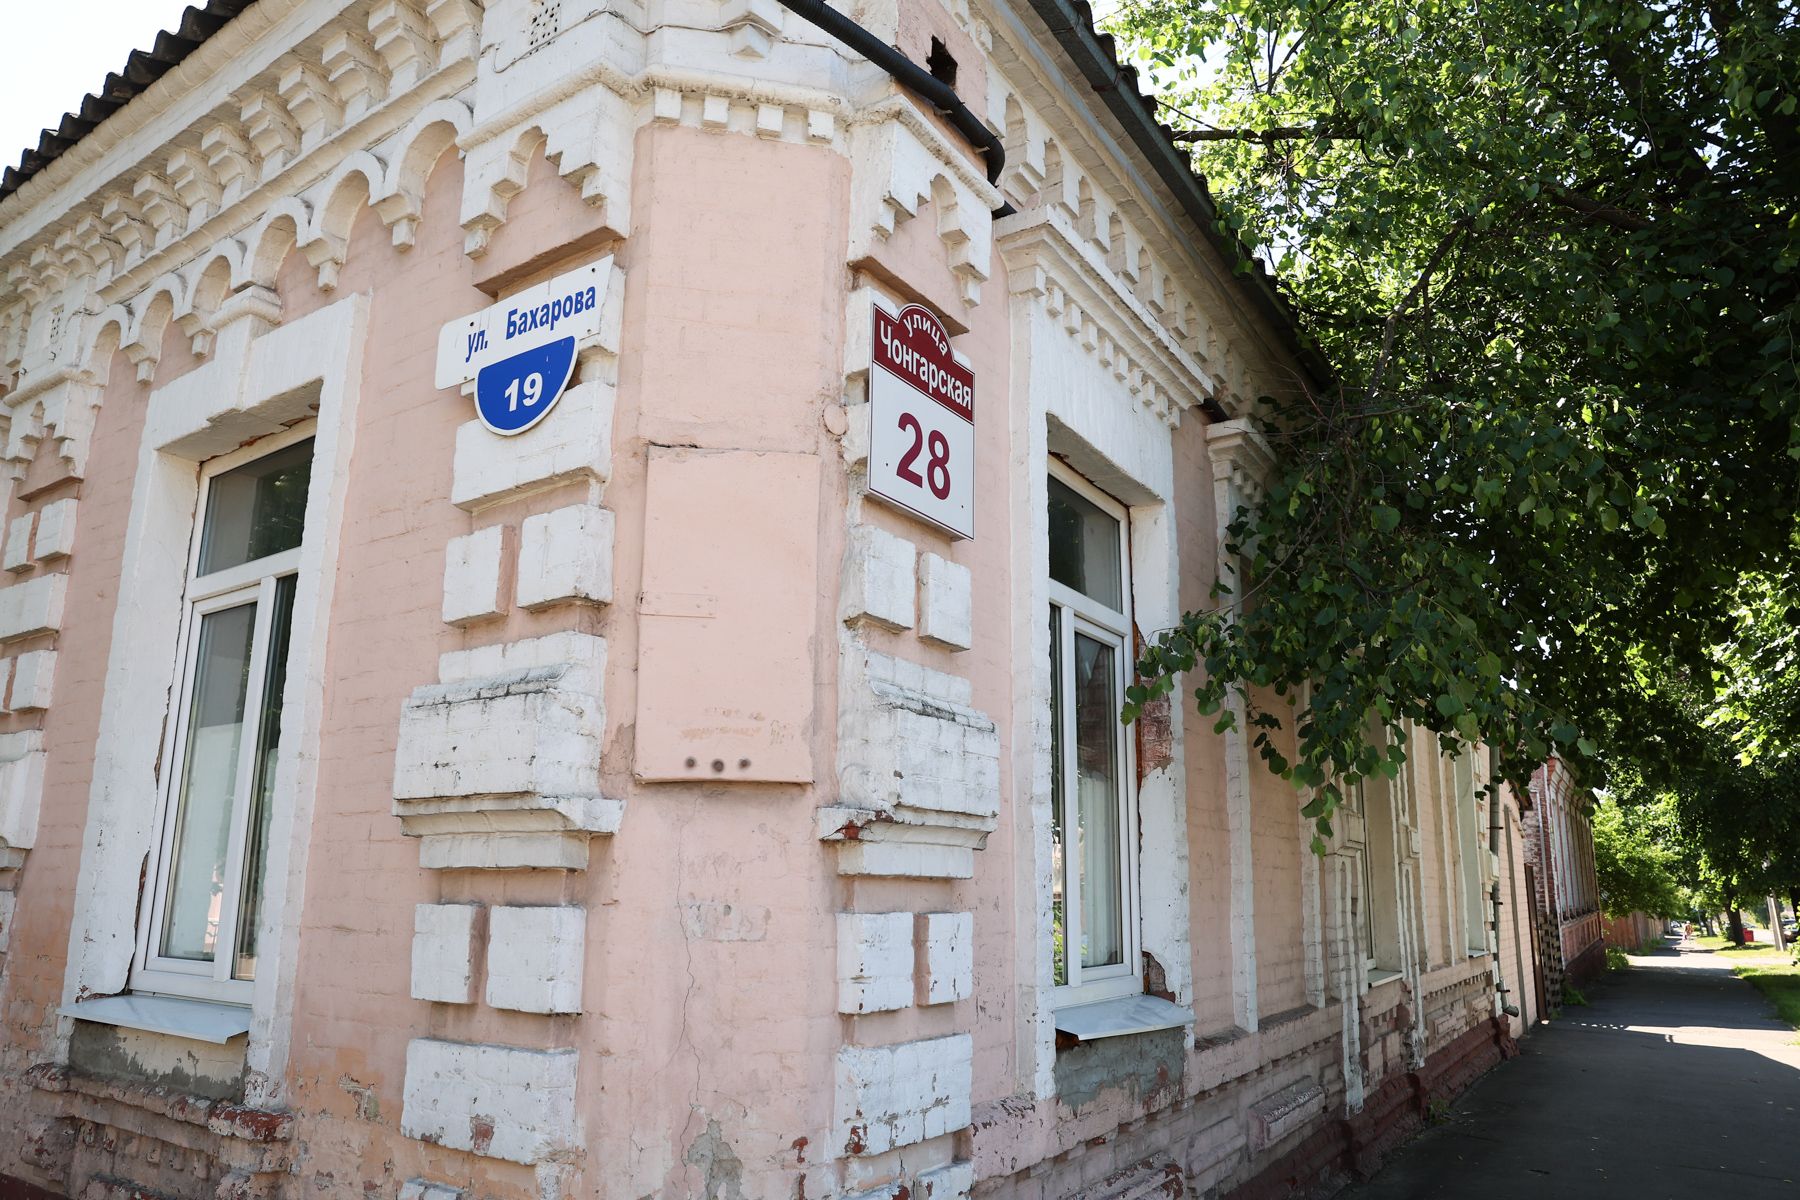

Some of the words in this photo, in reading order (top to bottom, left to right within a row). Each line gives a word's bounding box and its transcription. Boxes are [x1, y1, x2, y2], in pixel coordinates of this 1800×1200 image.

[465, 329, 488, 363] ул.
[506, 286, 596, 340] Бахарова
[903, 314, 949, 356] улица
[504, 372, 543, 412] 19
[880, 320, 972, 410] Чонгарская
[896, 412, 951, 501] 28
